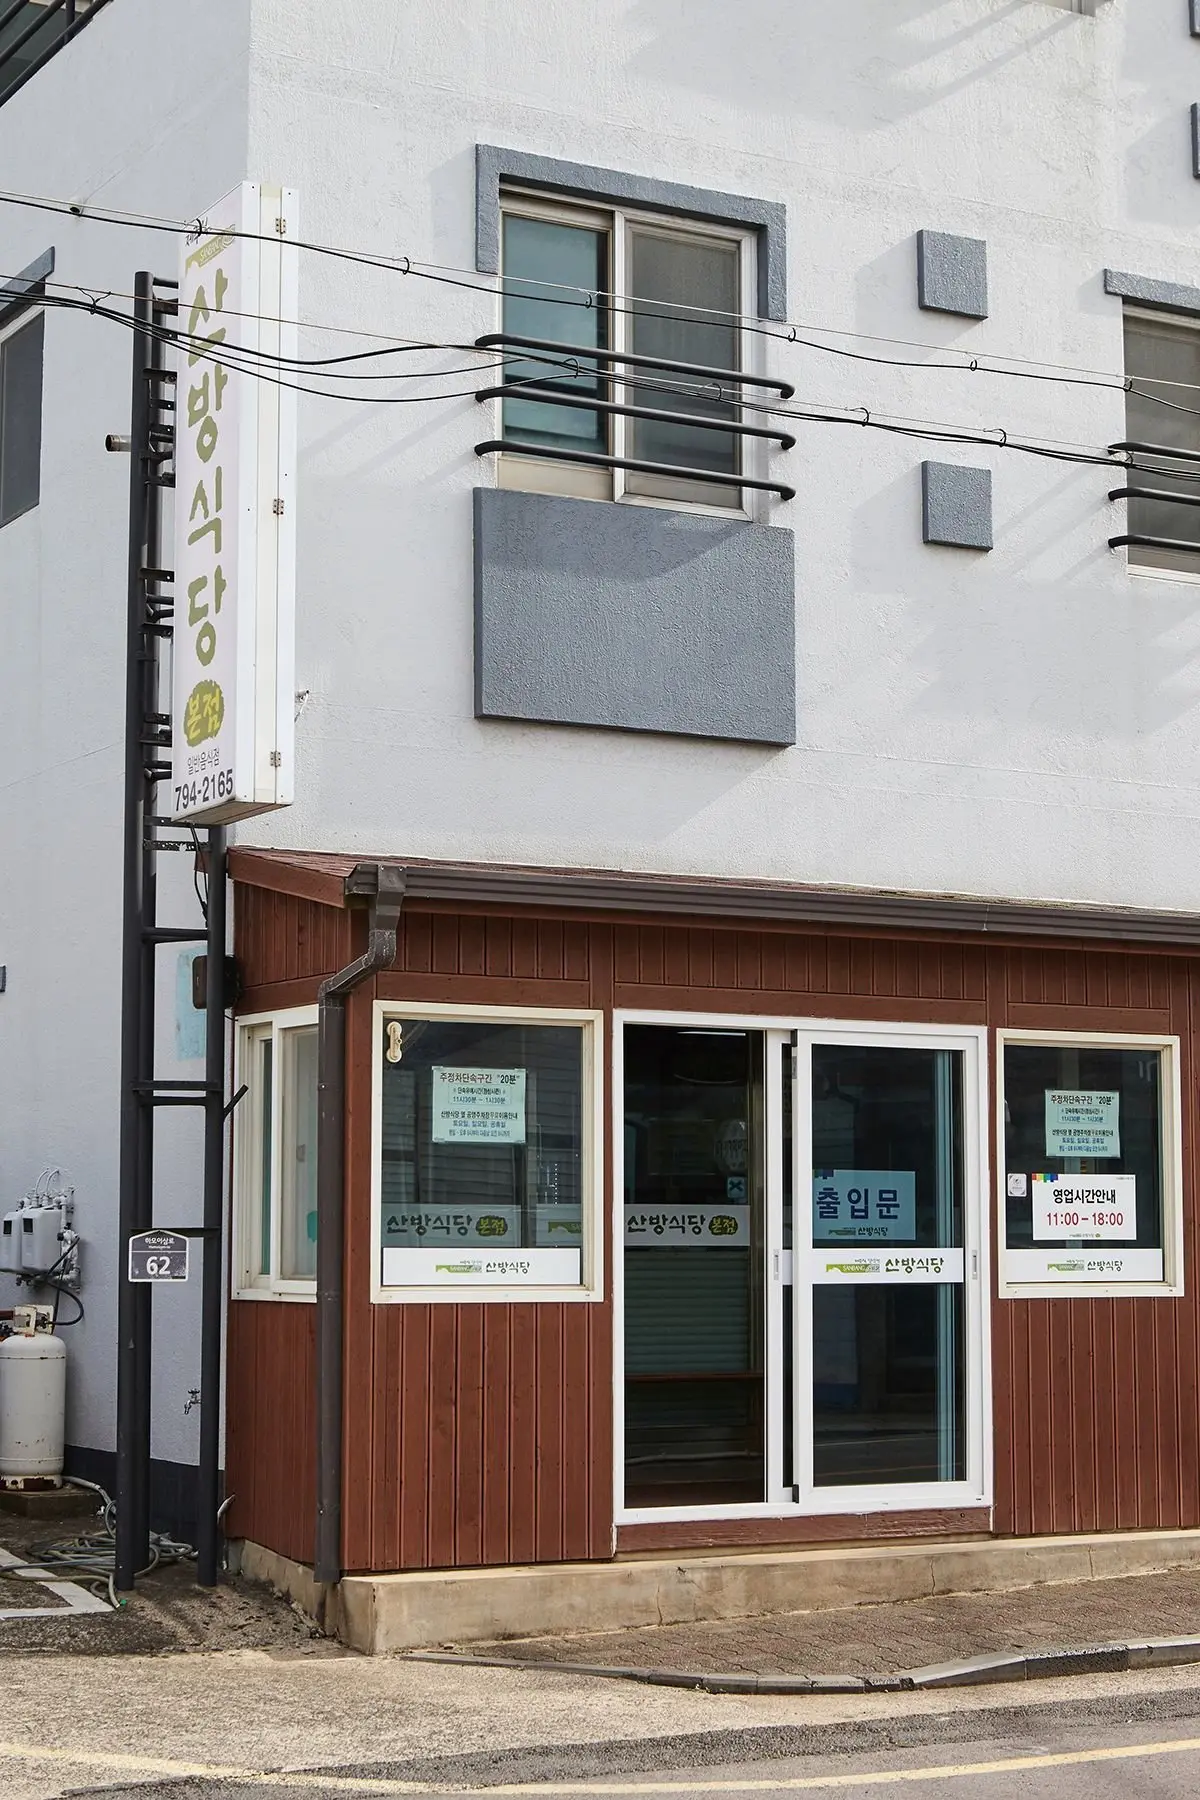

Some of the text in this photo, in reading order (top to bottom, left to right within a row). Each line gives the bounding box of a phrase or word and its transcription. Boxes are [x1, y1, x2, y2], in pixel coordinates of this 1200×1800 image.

[187, 268, 228, 667] 산방식당
[187, 688, 221, 740] 본점
[187, 748, 220, 775] 일반음식점
[175, 768, 233, 811] 794-2165
[440, 1072, 493, 1084] 주정차단속구간
[1051, 1094, 1093, 1104] 주정차단속구간
[816, 1187, 900, 1220] 출입문
[1053, 1188, 1116, 1204] 영업시간안내
[387, 1215, 505, 1236] 산방식당 본점
[627, 1214, 736, 1235] 산방식당 본점
[1047, 1212, 1079, 1226] 11:00
[1092, 1212, 1124, 1226] 18:00
[858, 1226, 888, 1237] 산방식당
[146, 1255, 171, 1275] 62
[485, 1261, 531, 1274] 산방식당
[885, 1257, 945, 1274] 산방식당
[1087, 1259, 1124, 1272] 산방식당
